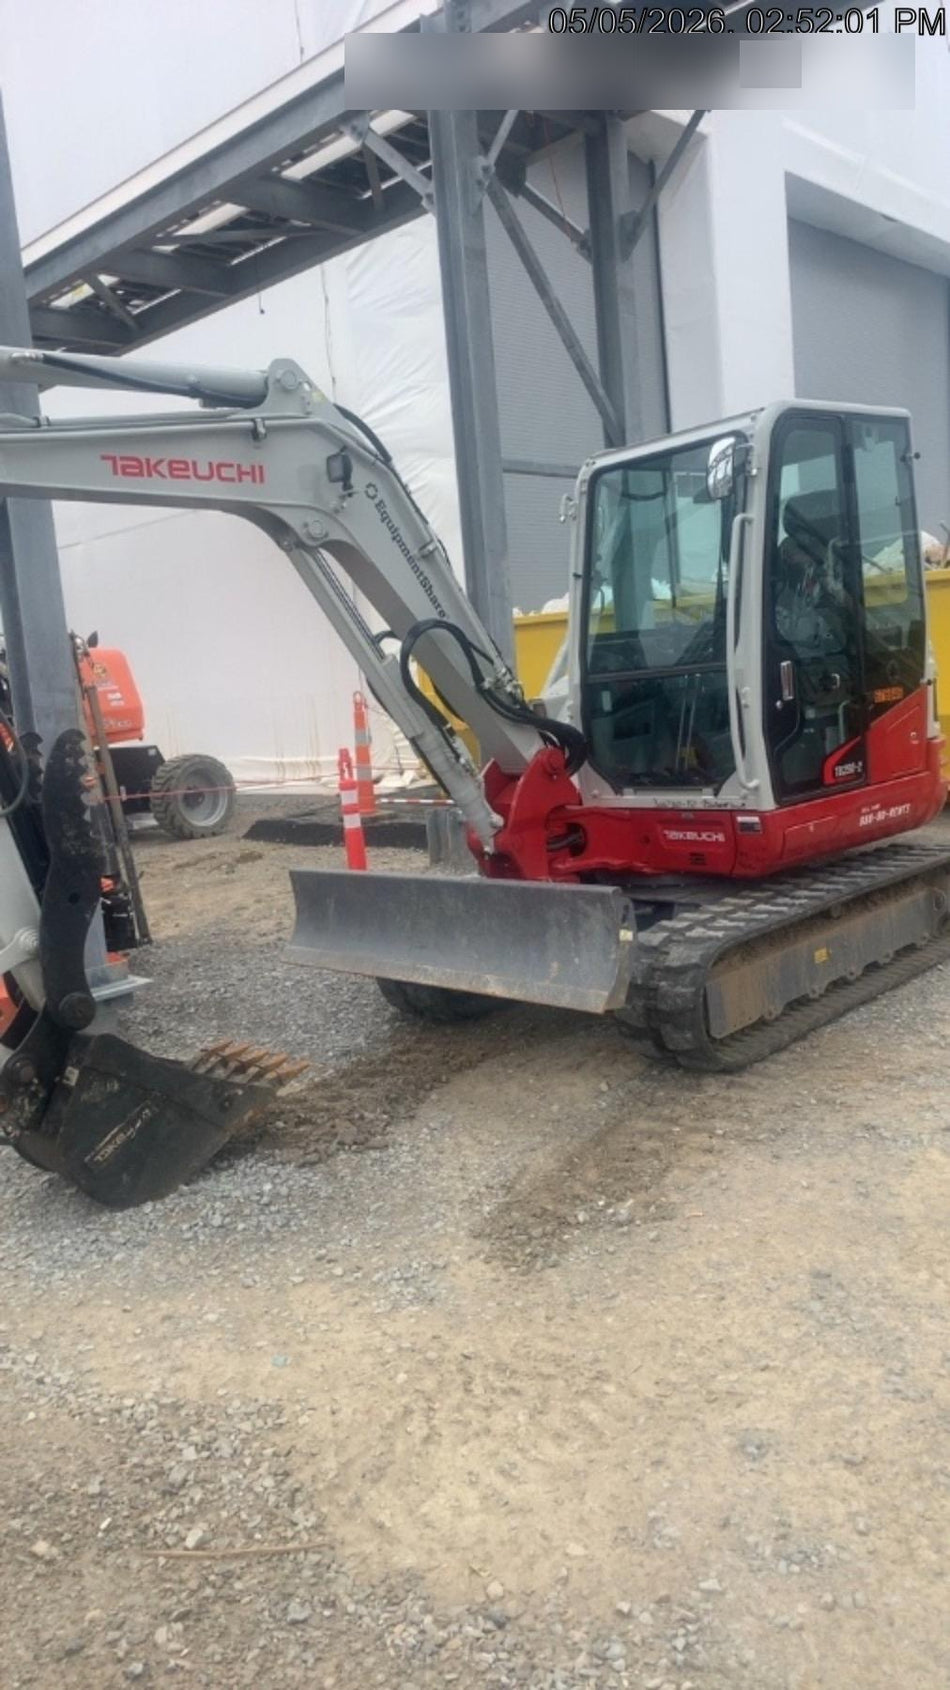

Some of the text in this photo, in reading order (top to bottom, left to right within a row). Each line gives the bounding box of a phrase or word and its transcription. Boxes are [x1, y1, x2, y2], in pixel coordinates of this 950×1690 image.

[100, 454, 265, 485] TAKEUCHI
[375, 500, 447, 618] EquipmentShare
[663, 829, 726, 842] TAKEUCHI
